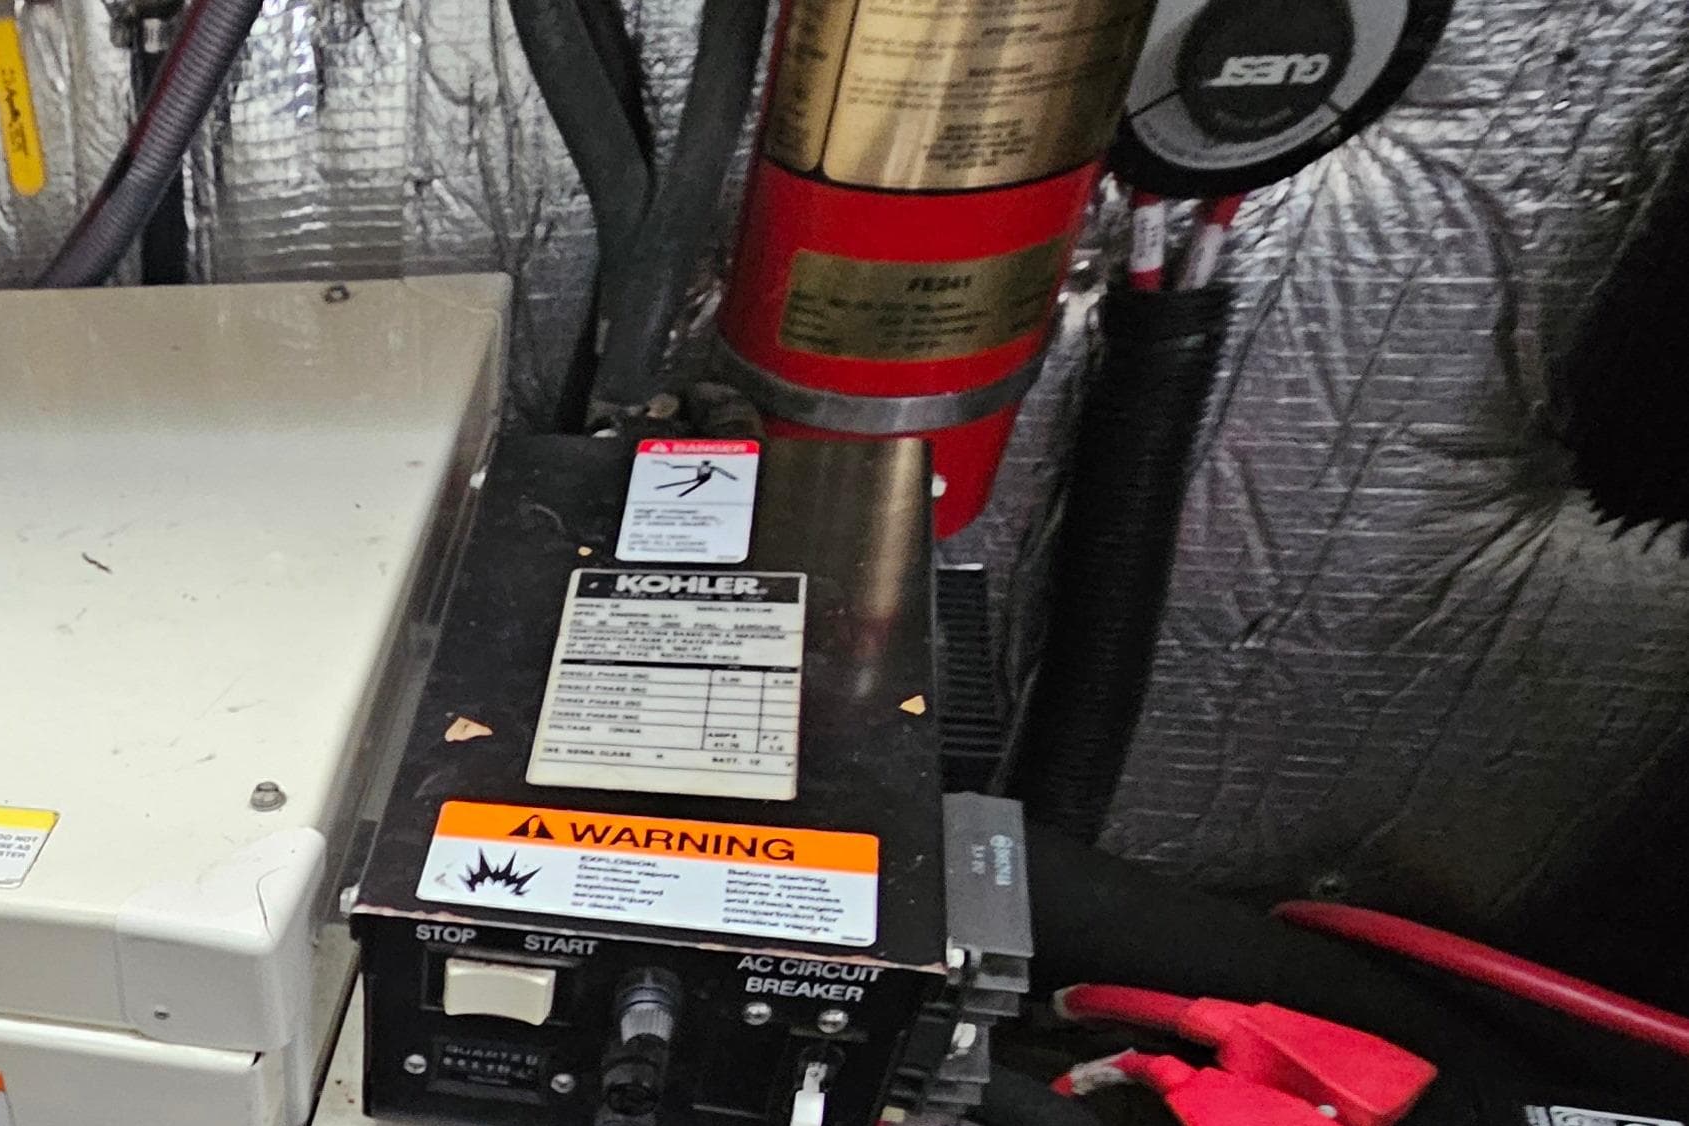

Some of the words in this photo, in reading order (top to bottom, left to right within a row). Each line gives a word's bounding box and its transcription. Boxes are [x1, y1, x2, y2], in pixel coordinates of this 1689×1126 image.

[1207, 53, 1330, 87] GUEST
[615, 574, 762, 595] KOHLER
[570, 822, 796, 862] WARNING
[415, 924, 478, 944] STOP
[524, 934, 599, 955] START
[737, 955, 775, 973] AC
[779, 959, 884, 983] CIRCUIT
[745, 976, 865, 1002] BREAKER
